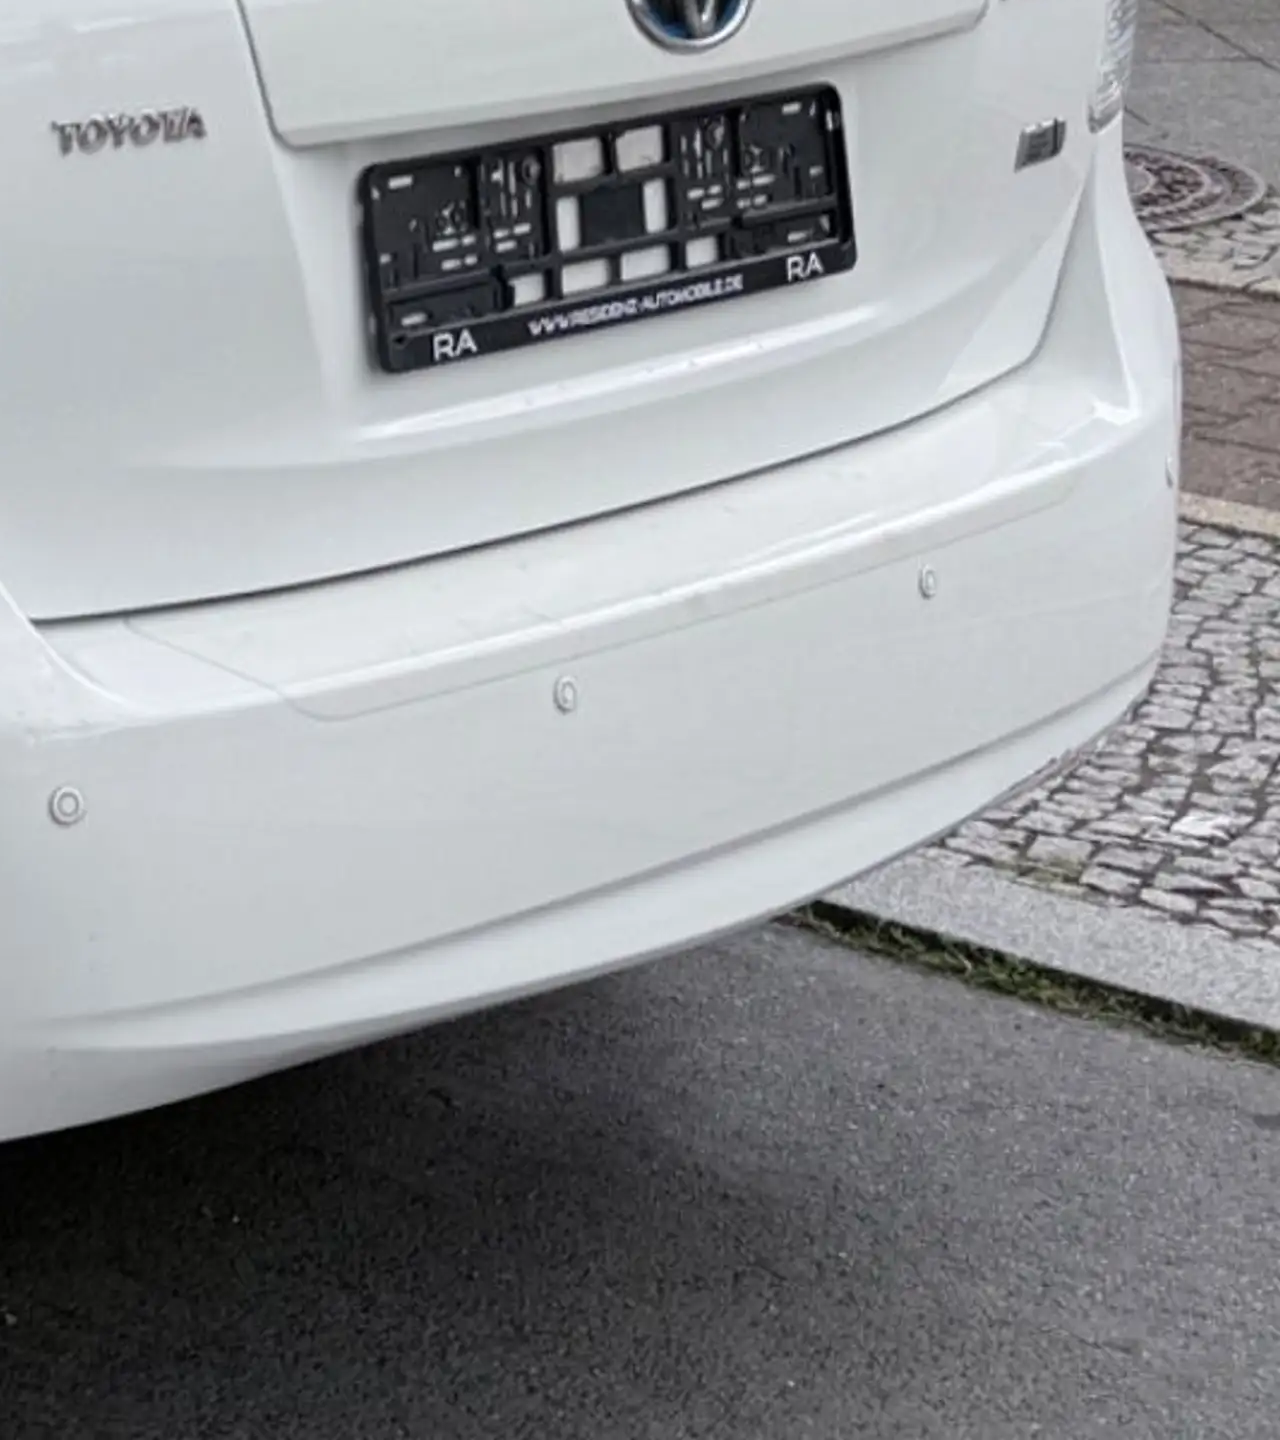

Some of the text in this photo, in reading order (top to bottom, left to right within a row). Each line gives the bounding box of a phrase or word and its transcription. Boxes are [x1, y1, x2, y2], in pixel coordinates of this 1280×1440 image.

[50, 106, 208, 158] TOYOTA
[433, 251, 824, 362] RA RA
